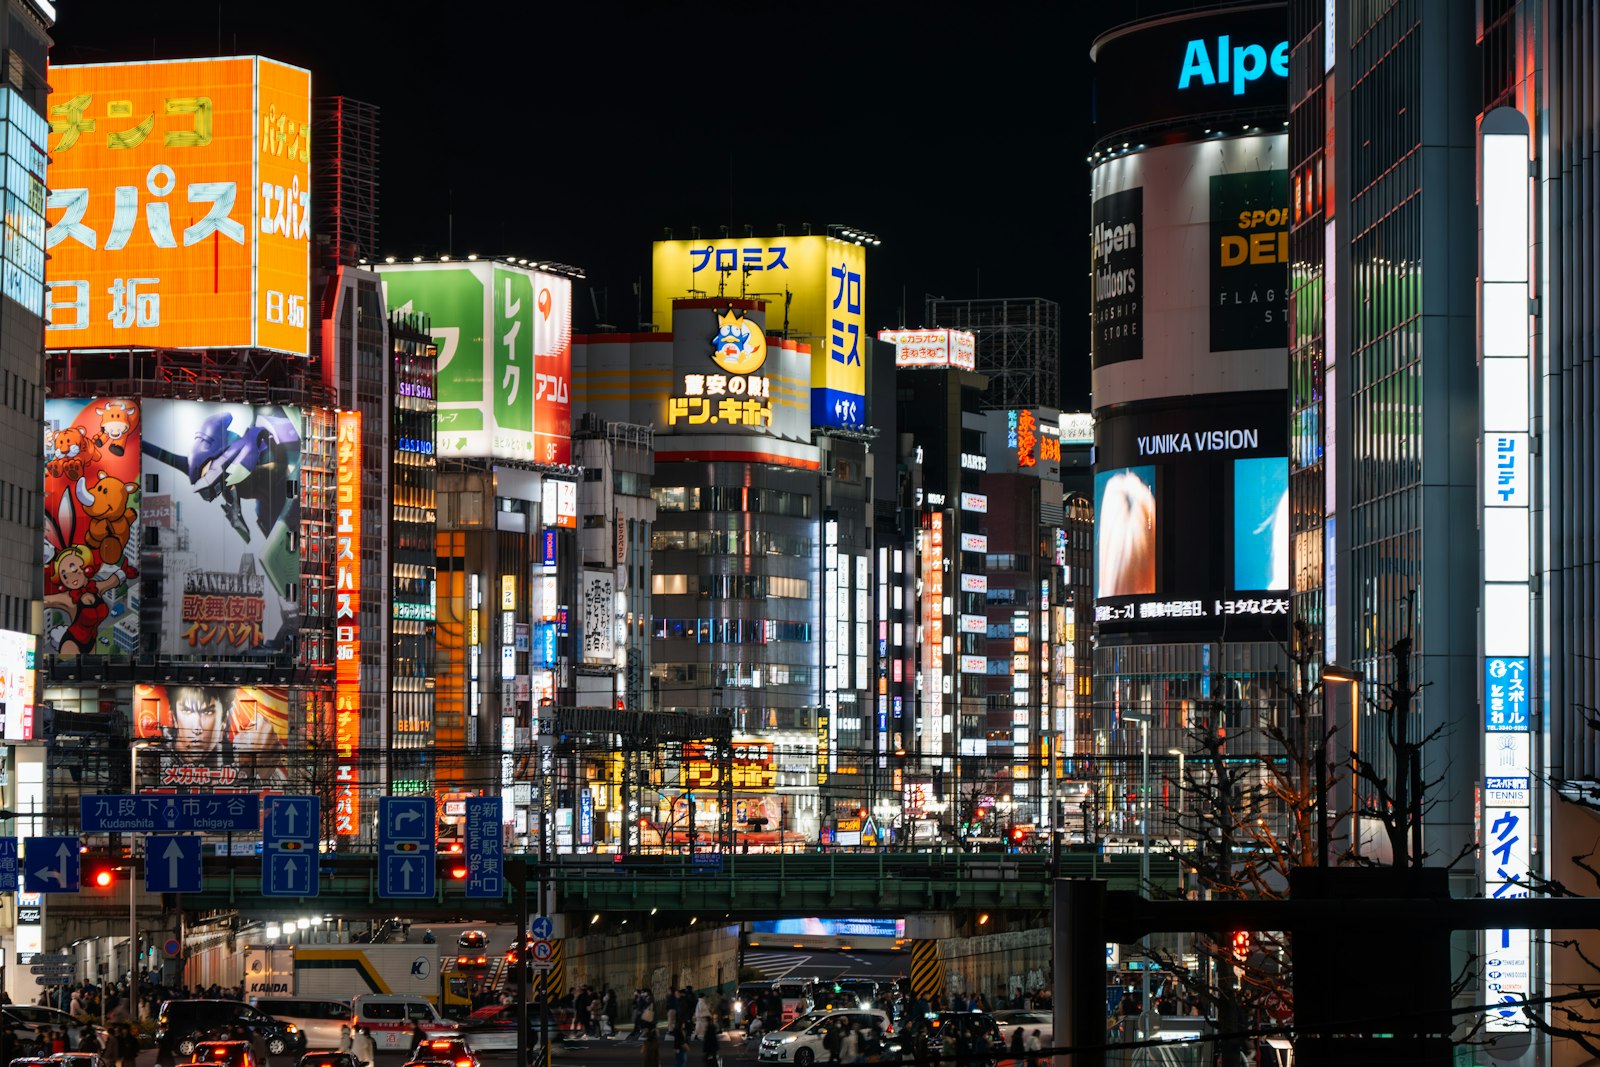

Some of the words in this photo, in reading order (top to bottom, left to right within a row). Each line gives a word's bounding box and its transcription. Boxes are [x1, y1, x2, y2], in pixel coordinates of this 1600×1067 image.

[1094, 222, 1136, 264] Alpen
[690, 246, 789, 272] プロミス
[1096, 265, 1136, 302] Outdoors
[503, 277, 522, 406] レイク
[907, 335, 939, 343] カラオケ
[1104, 323, 1137, 341] STORE
[901, 347, 945, 361] まねきねこ
[400, 382, 432, 399] SHISHA
[535, 372, 569, 404] アコム
[399, 437, 433, 455] CASINO
[546, 442, 558, 460] 3F
[1138, 433, 1192, 455] YUNIKA
[1195, 429, 1258, 452] VISION
[338, 424, 353, 503] パチンコ
[961, 453, 987, 472] DARTS
[183, 596, 266, 621] 歌舞伎町
[181, 621, 265, 648] インパクト
[1508, 660, 1525, 724] ベースボール
[1491, 684, 1504, 724] ときわ
[398, 719, 431, 733] BEAUTY
[163, 767, 237, 785] メガホール
[337, 765, 353, 833] エスパス
[1489, 791, 1524, 800] TENNIS
[95, 799, 159, 817] 九段下
[166, 808, 176, 819] 4
[100, 817, 154, 829] Kudanshita
[193, 818, 235, 829] Ichigaya
[469, 804, 482, 850] Shinjuku
[482, 801, 499, 893] 新宿駅東口
[251, 983, 288, 993] KANDA
